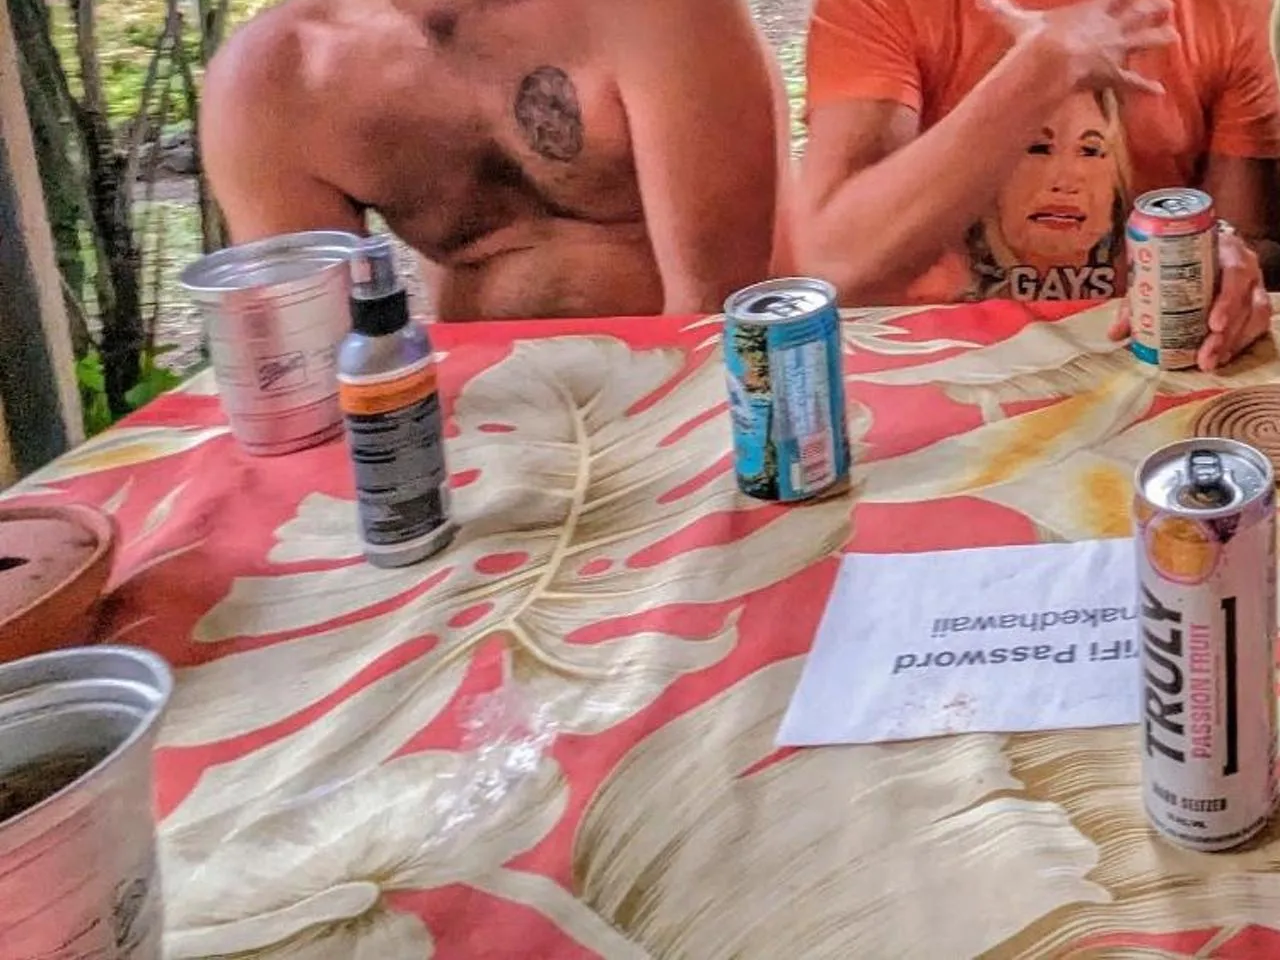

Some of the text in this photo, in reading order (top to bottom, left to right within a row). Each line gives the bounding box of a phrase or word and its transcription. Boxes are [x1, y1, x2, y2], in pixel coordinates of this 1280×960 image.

[1010, 265, 1116, 301] GAYS
[930, 607, 1139, 638] nakedhawaii
[892, 640, 1139, 675] iFi Password
[1142, 583, 1186, 764] TRULY
[1188, 623, 1212, 759] PASSION FRUIT
